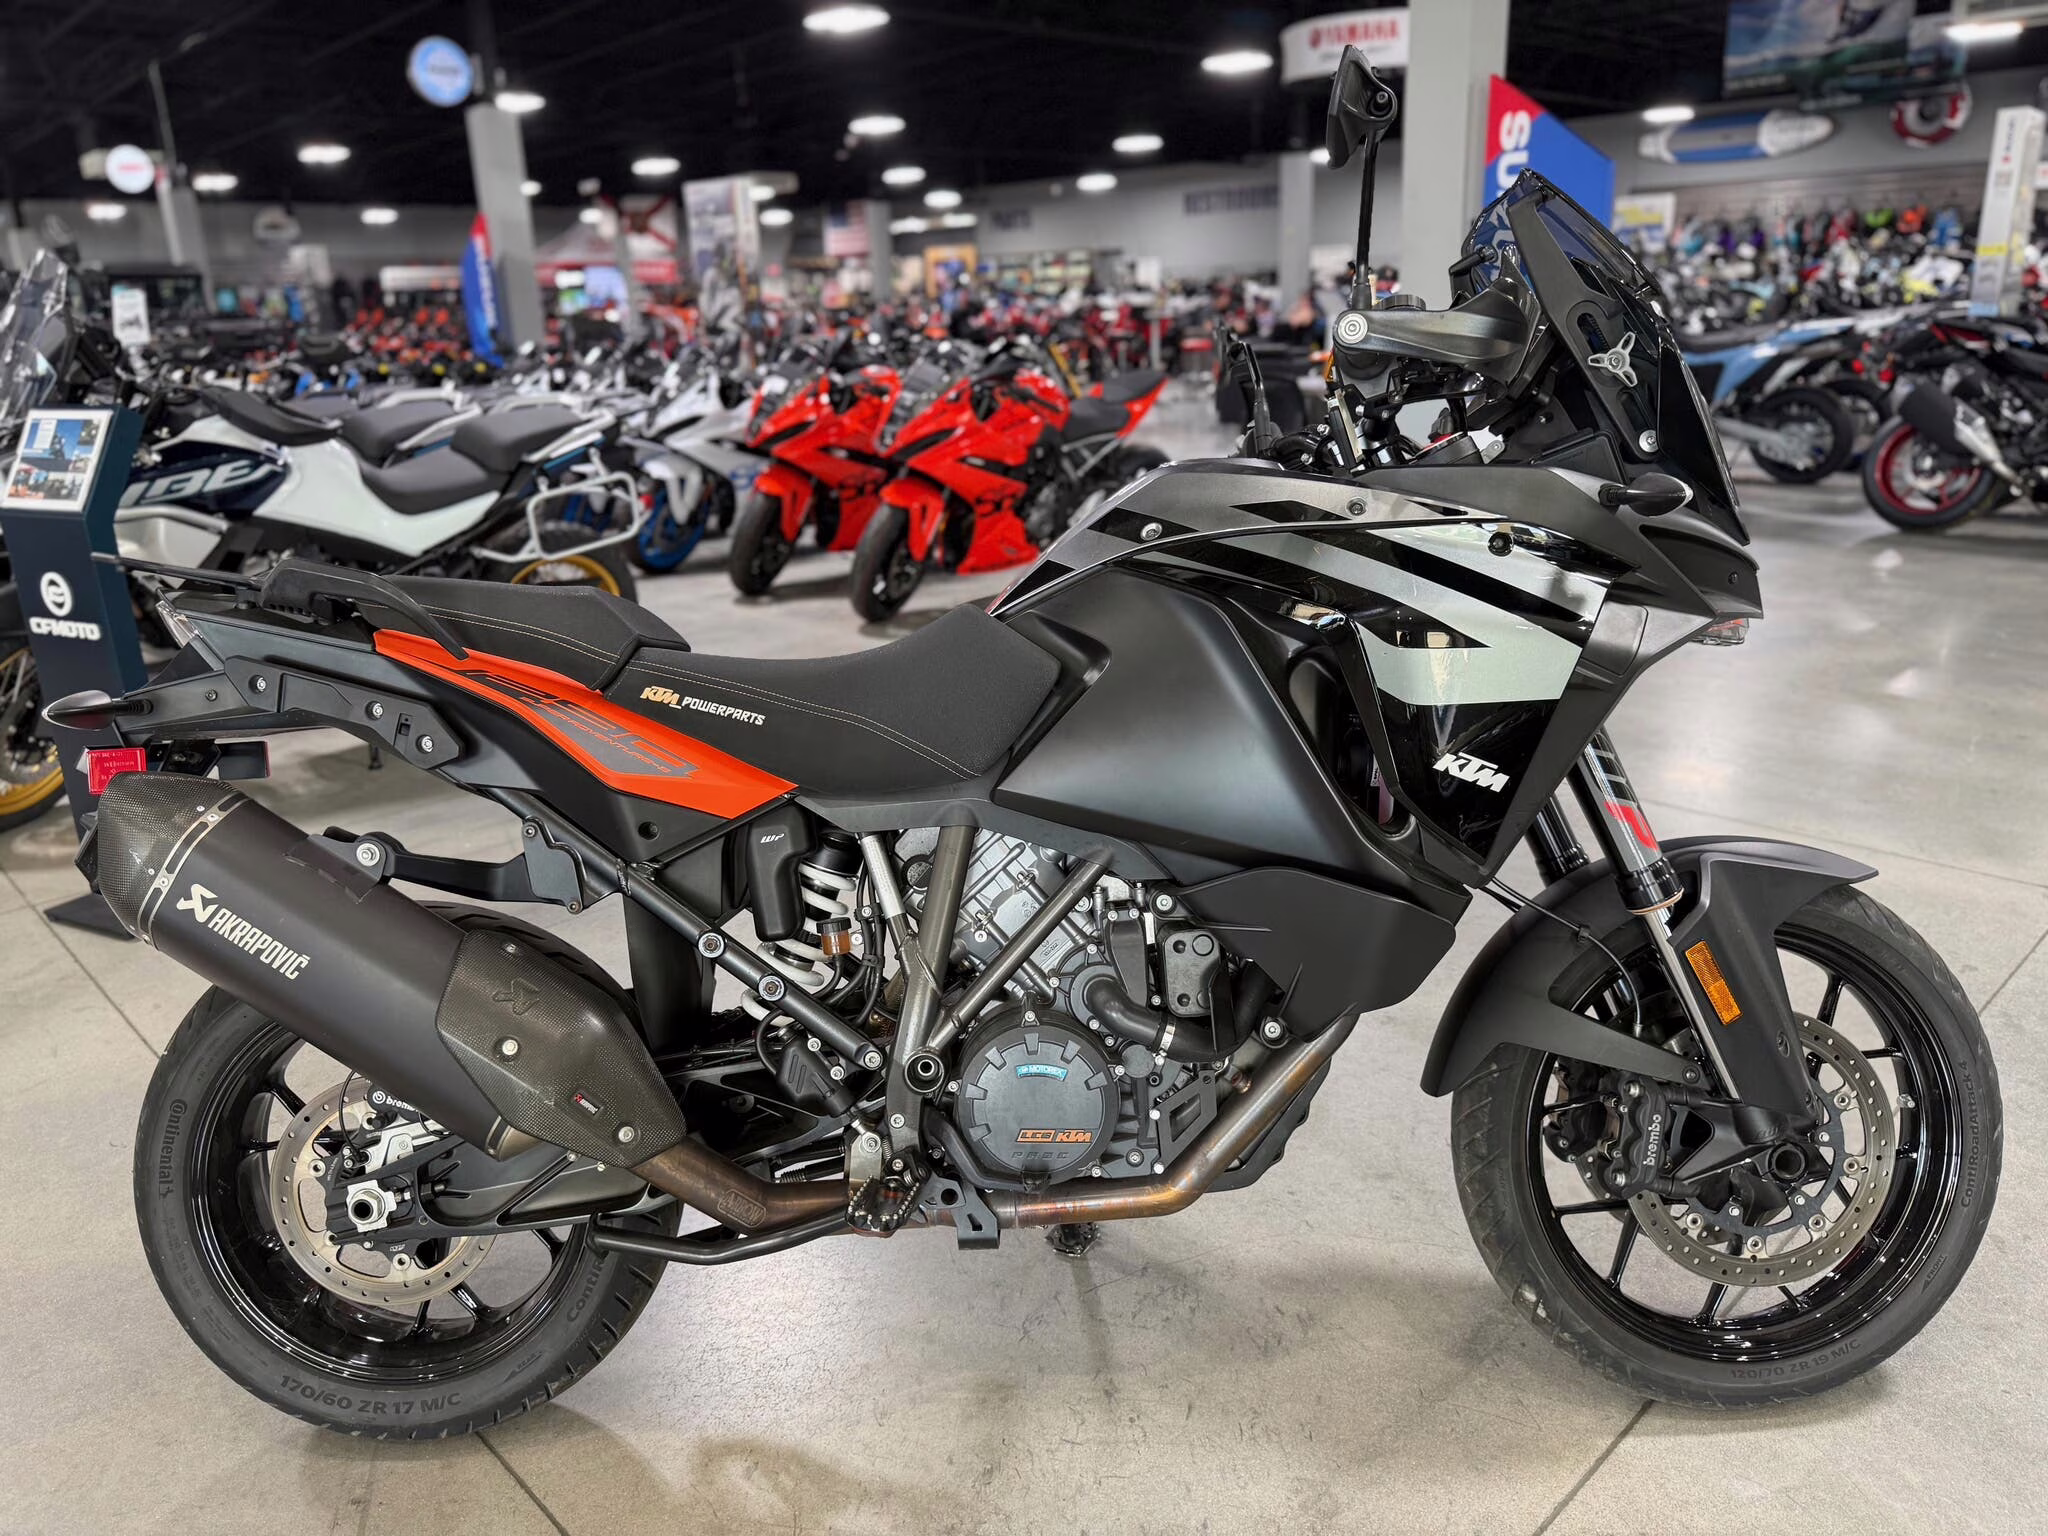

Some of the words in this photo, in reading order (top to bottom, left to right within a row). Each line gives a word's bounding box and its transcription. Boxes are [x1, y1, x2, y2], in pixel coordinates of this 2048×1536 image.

[29, 617, 101, 640] CFMOTO
[640, 686, 680, 705] KTM
[681, 697, 765, 725] POWERPARTS
[1432, 752, 1510, 792] KTM
[1056, 1129, 1092, 1142] KTM
[1643, 1114, 1662, 1166] brembo
[1731, 1366, 1785, 1379] 120/70
[1790, 1360, 1811, 1373] ZR
[1814, 1354, 1829, 1366] 19
[1830, 1339, 1861, 1359] M/C
[280, 1375, 352, 1410] 170/60
[358, 1400, 387, 1414] ZR
[393, 1401, 415, 1414] 17
[420, 1392, 462, 1413] M/C
